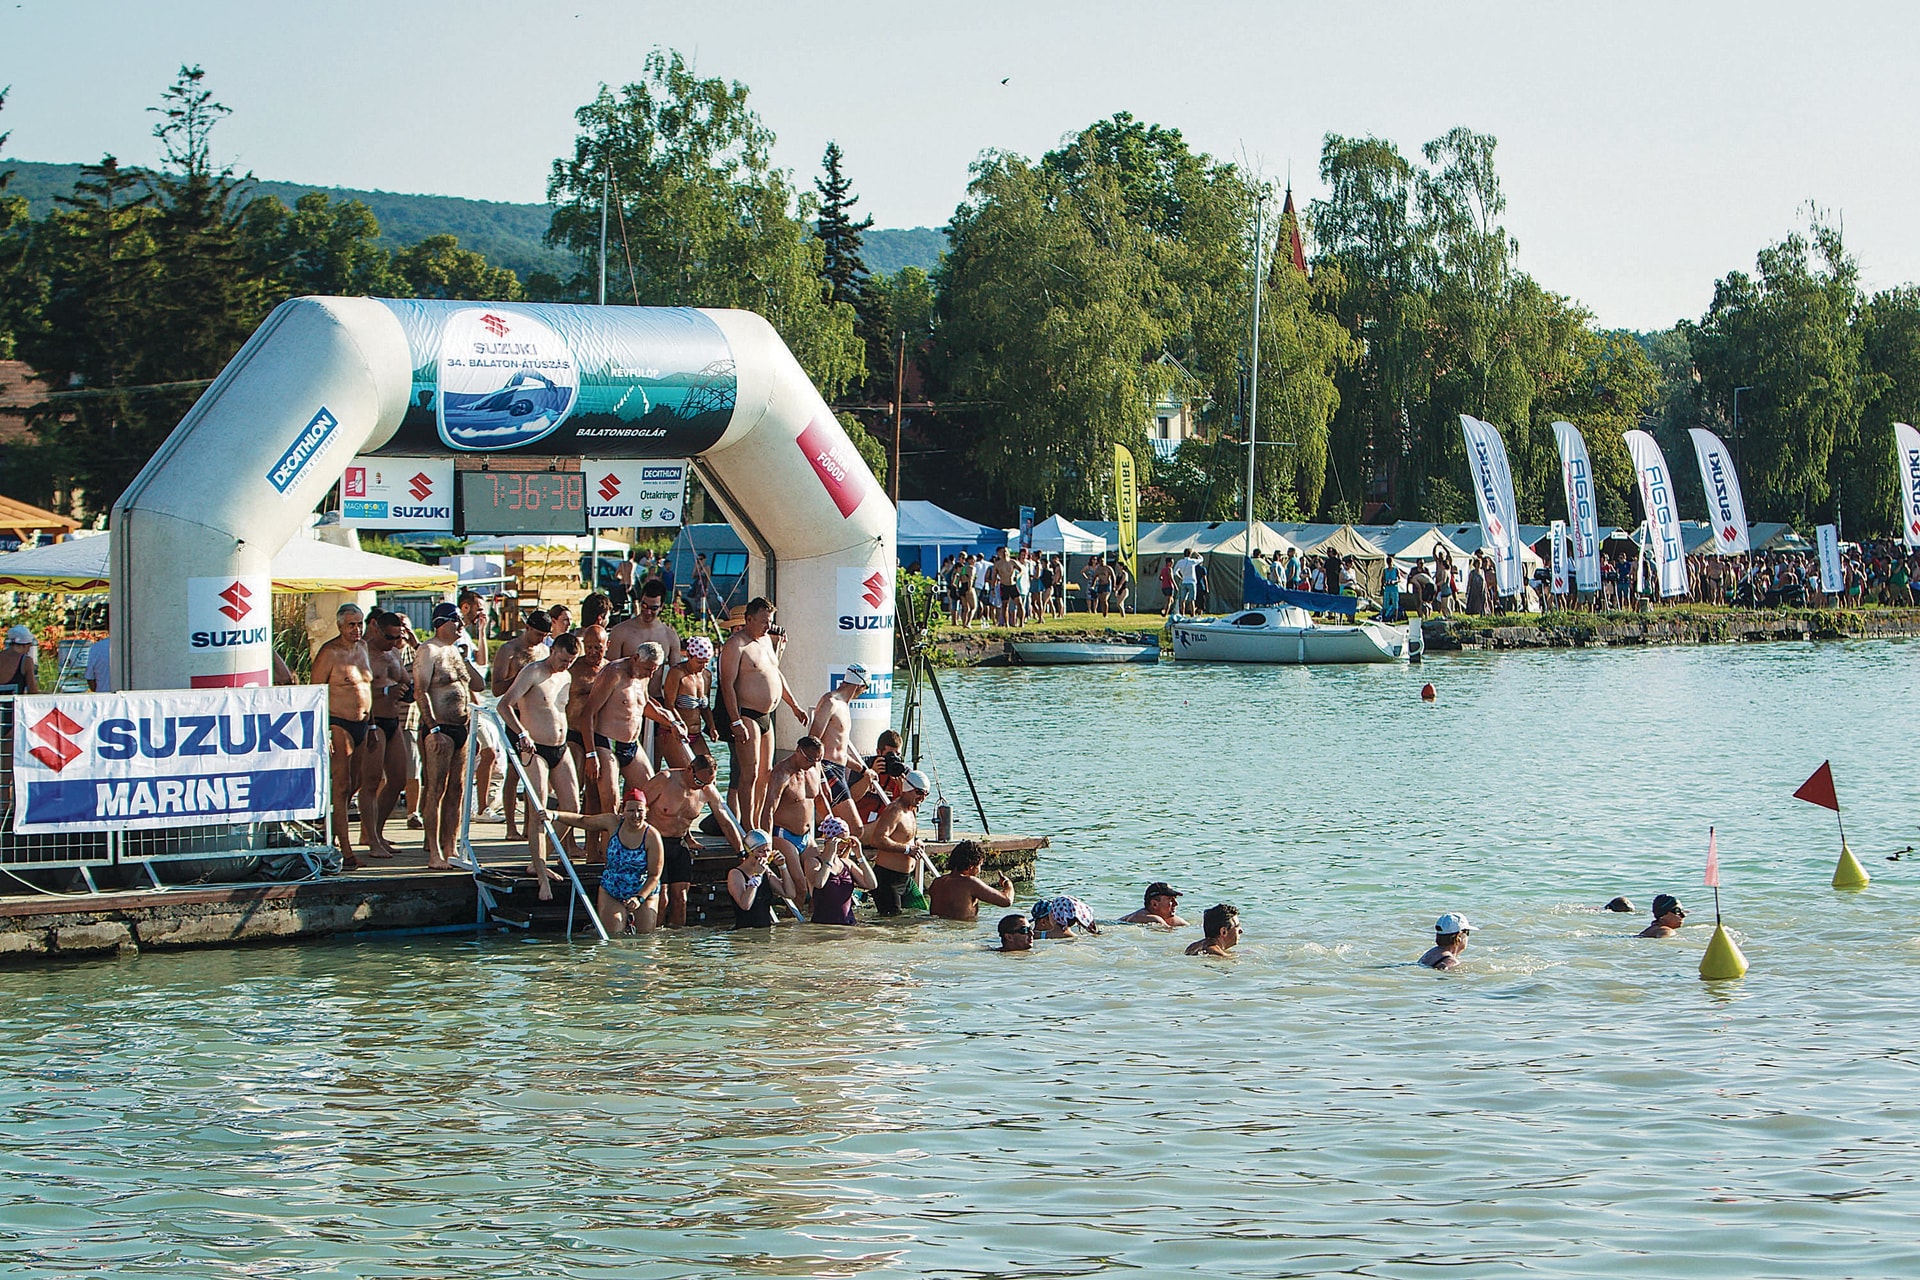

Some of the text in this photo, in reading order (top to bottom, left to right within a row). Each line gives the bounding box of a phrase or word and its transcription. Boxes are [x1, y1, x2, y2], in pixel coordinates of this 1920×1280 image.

[473, 342, 538, 356] SUZUKI
[447, 359, 466, 367] 34.
[575, 427, 668, 437] BALATONBOGLÁR
[273, 414, 333, 486] DECATHLON
[643, 469, 680, 478] DECATHLON
[817, 451, 846, 482] FOGOD
[485, 475, 582, 510] 7:36:38
[640, 490, 680, 501] Ottakringer
[392, 506, 450, 518] SUZUKI
[839, 615, 893, 630] SUZUK
[191, 627, 268, 648] SUZUKI
[96, 710, 315, 760] SUZUKI
[95, 776, 250, 817] MARINE
